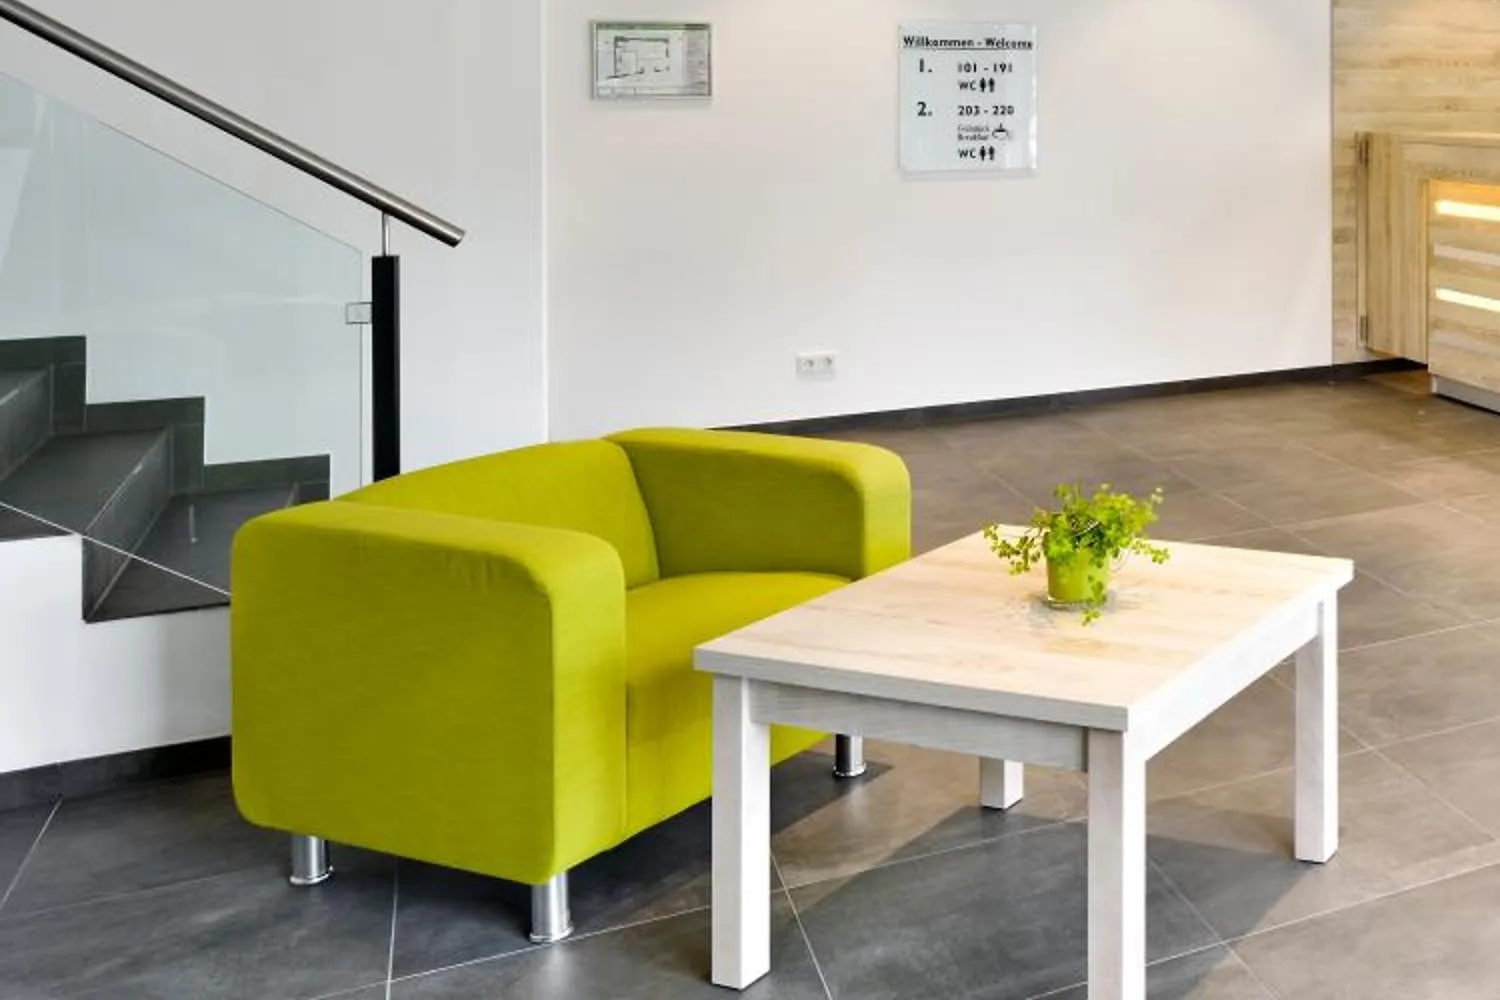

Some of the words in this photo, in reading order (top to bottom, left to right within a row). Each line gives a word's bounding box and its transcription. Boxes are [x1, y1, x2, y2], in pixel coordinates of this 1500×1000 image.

[903, 35, 974, 47] Willkommen
[984, 37, 1033, 49] Welcome
[919, 58, 933, 73] 1.
[958, 62, 977, 73] 101
[993, 62, 1013, 73] 191
[958, 81, 977, 91] WC
[917, 101, 933, 116] 2.
[958, 105, 980, 116] 203
[958, 149, 977, 159] WC
